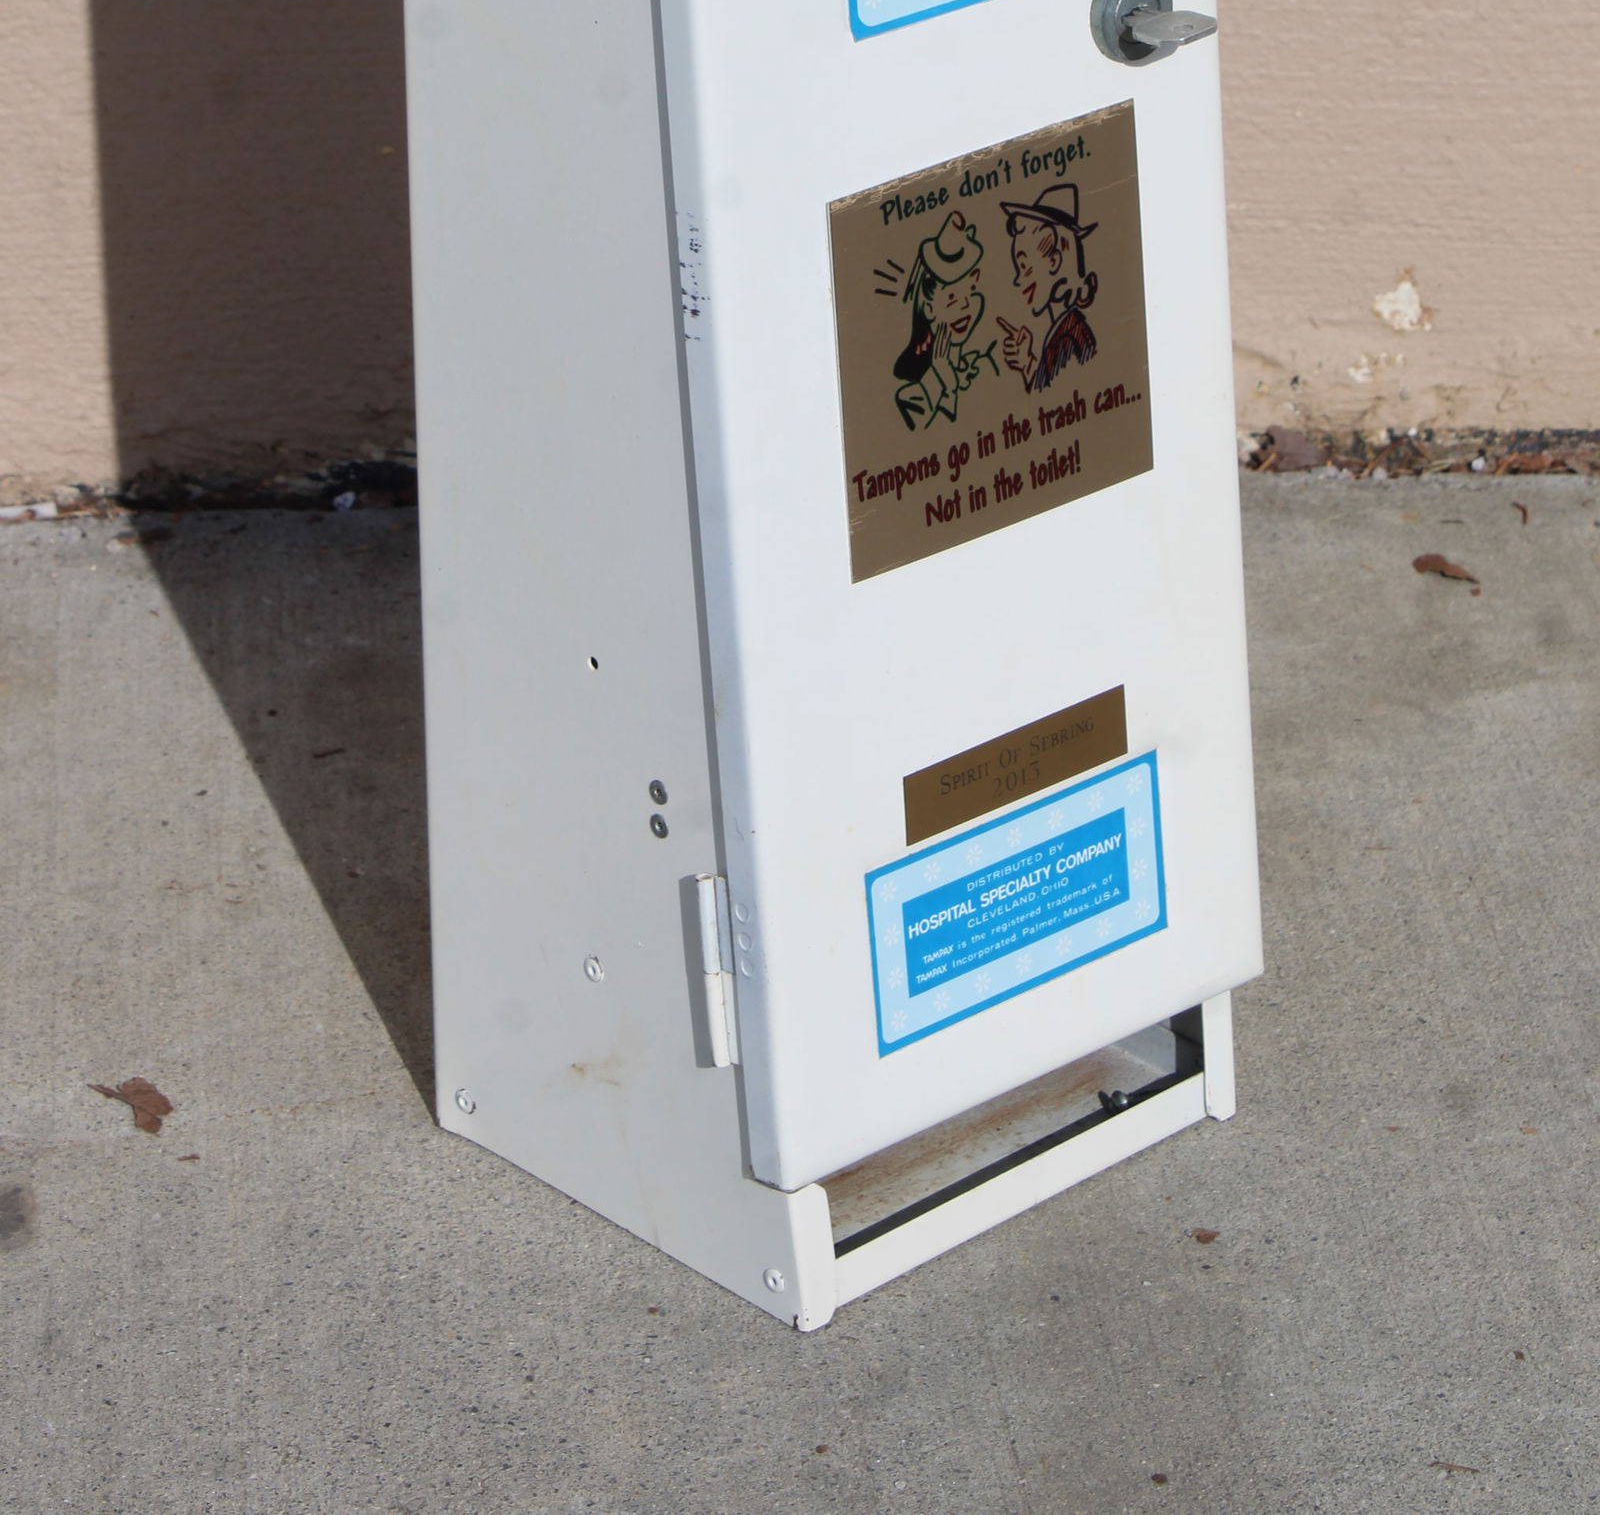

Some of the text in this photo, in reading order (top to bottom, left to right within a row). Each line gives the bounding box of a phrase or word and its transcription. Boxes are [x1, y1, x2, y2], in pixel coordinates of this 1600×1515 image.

[880, 136, 1091, 226] Please don't forget.
[853, 383, 1142, 502] Tampons go in the trash can...
[925, 440, 1081, 527] Not in the toilet!
[908, 833, 1122, 940] HOSPITAL SPECIALTY COMPANY
[967, 842, 1065, 892] DISTRIBUTED BY
[1041, 877, 1069, 896] OHIO
[922, 873, 1113, 965] TAMPAX is the registered trademark of
[915, 964, 948, 985] TAMPAX
